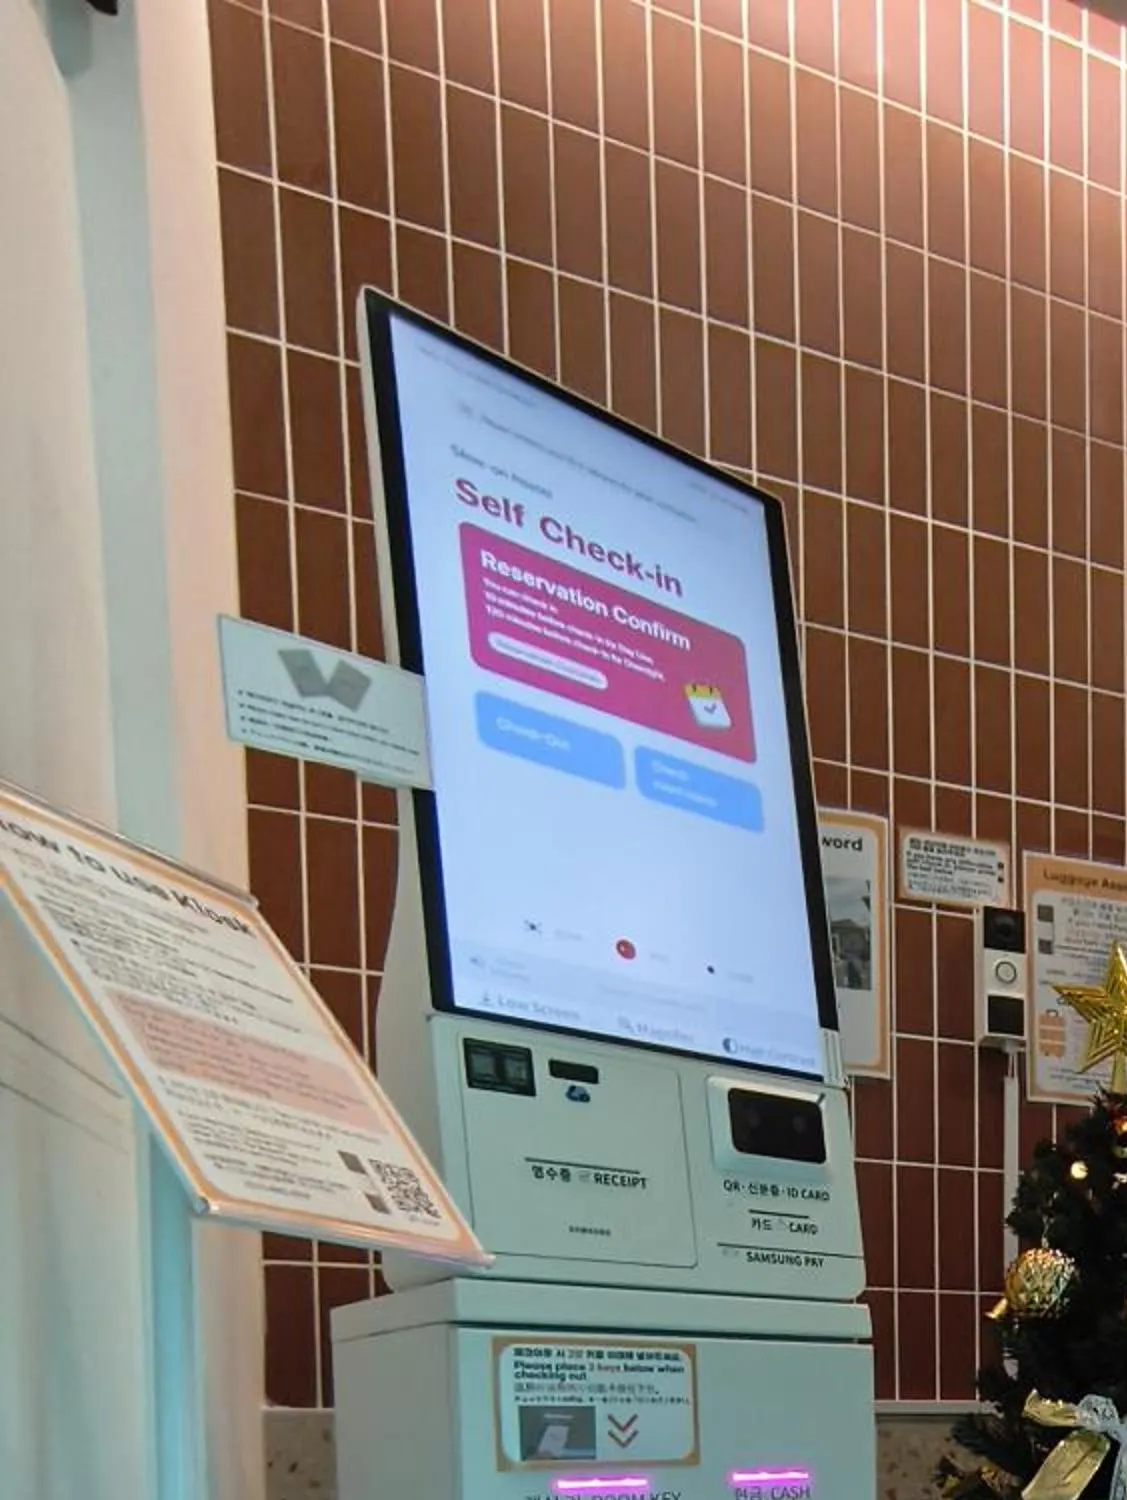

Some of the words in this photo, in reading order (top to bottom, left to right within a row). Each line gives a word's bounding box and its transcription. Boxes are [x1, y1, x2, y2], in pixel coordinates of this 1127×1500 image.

[456, 477, 525, 528] Self
[539, 515, 684, 598] Check-in
[480, 549, 609, 617] Reservation
[612, 605, 691, 650] Confirm
[1043, 868, 1098, 886] Luggage
[532, 1165, 571, 1183] 영수증
[594, 1172, 647, 1190] RECEIPT
[801, 1188, 830, 1201] CARD
[751, 1217, 772, 1231] 카드
[789, 1222, 818, 1235] CARD
[746, 1251, 802, 1266] SAMSUNG
[804, 1255, 824, 1268] PAY
[513, 1360, 552, 1371] Please
[513, 1370, 566, 1382] checking
[568, 1371, 587, 1380] out
[771, 1485, 811, 1500] CASH
